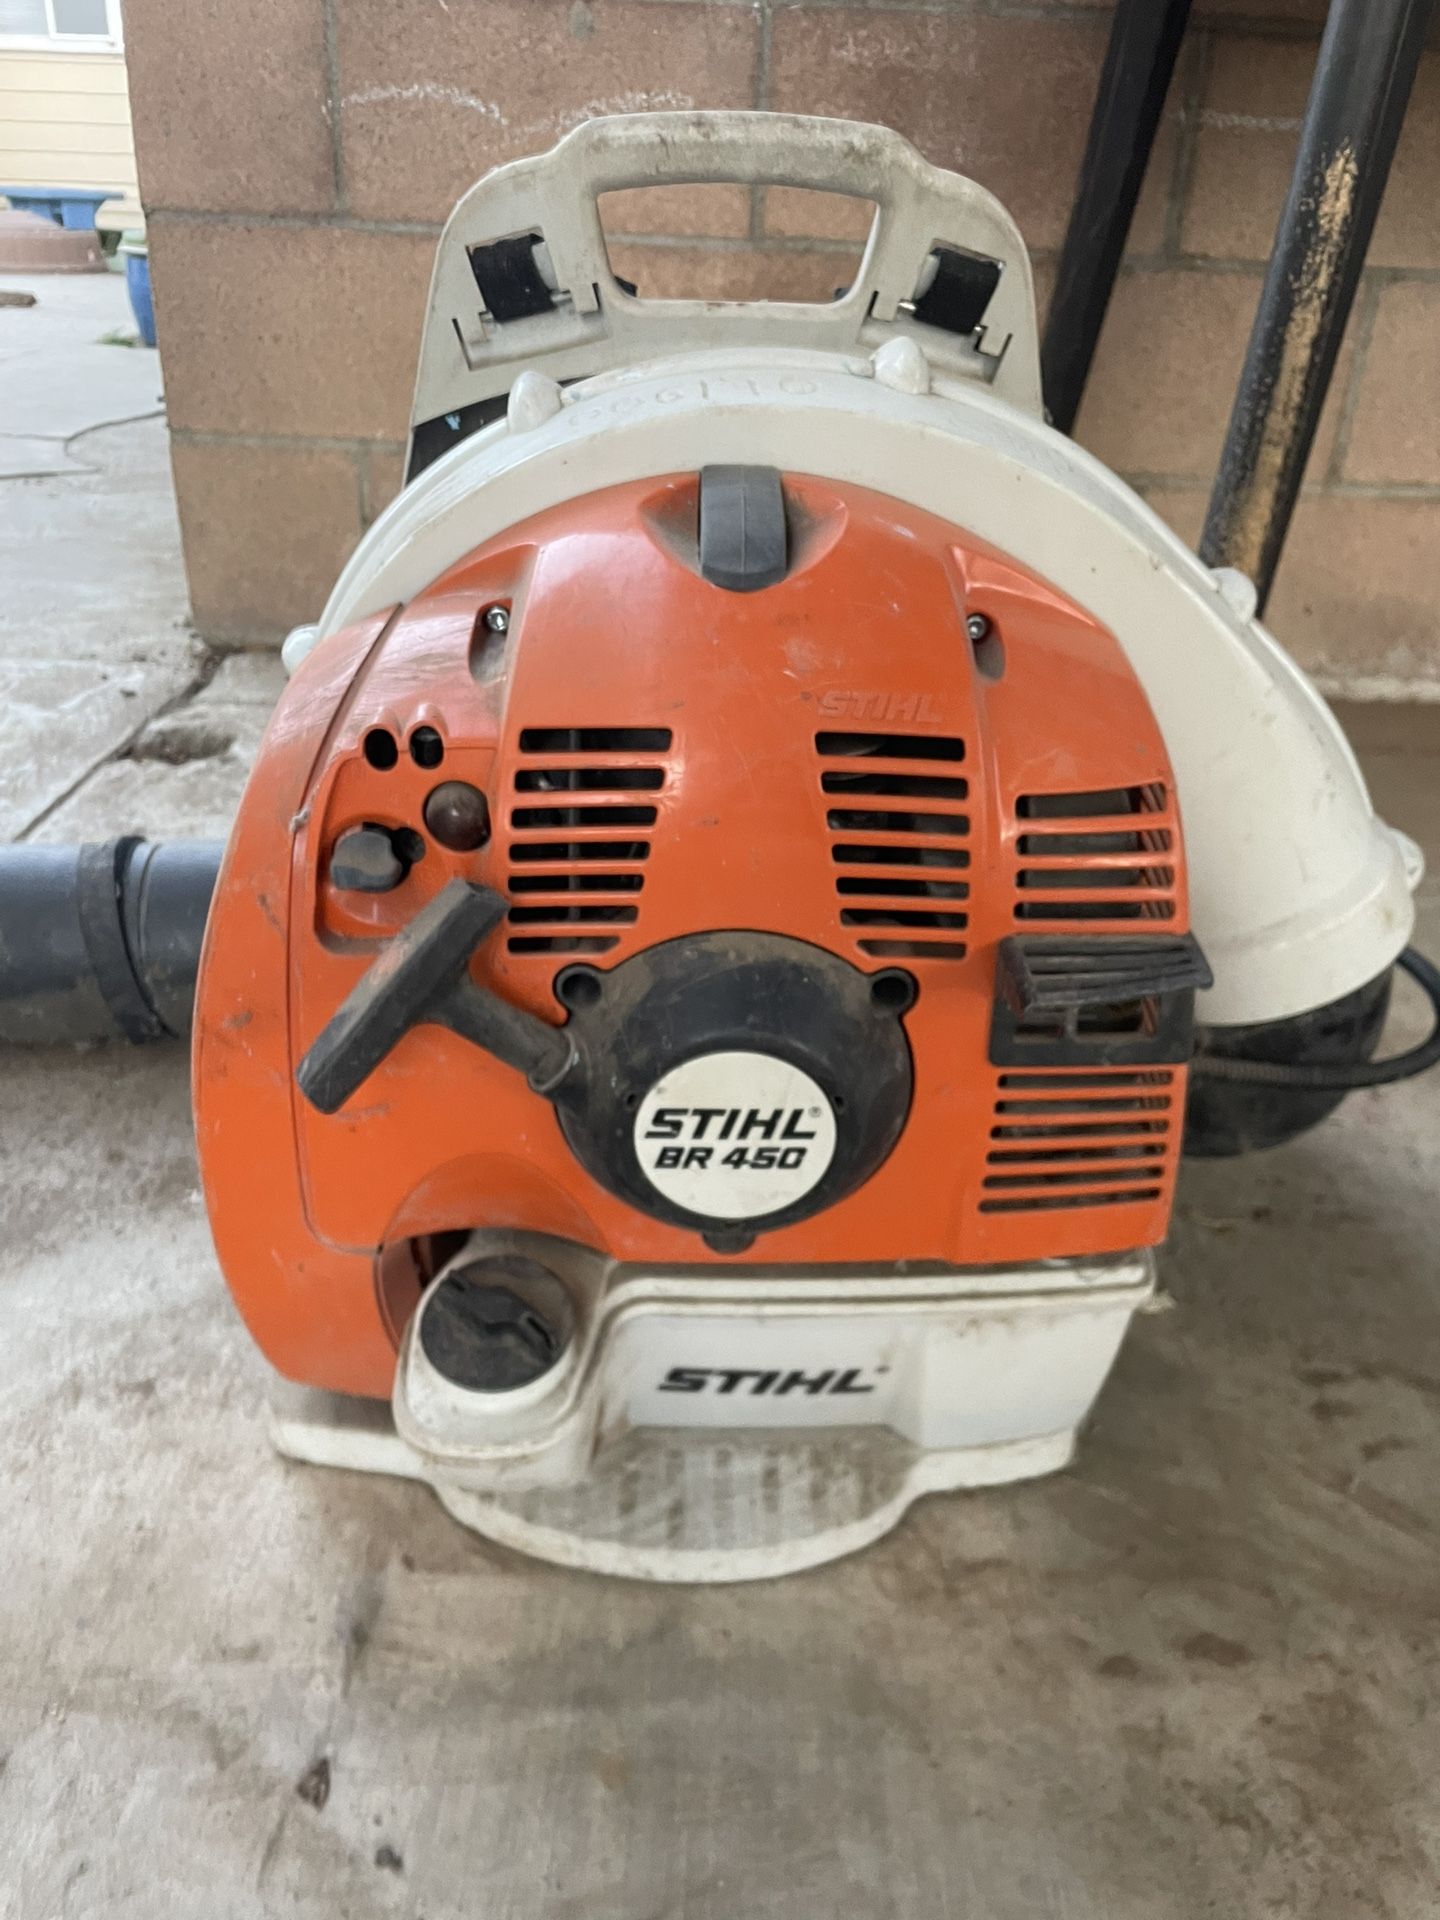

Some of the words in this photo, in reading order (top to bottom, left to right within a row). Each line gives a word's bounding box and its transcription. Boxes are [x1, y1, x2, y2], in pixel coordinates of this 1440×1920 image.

[817, 690, 943, 723] STIHL
[644, 1108, 817, 1140] STIHL
[654, 1147, 714, 1169] BR
[721, 1147, 808, 1169] 450
[656, 1367, 875, 1395] STIHL
